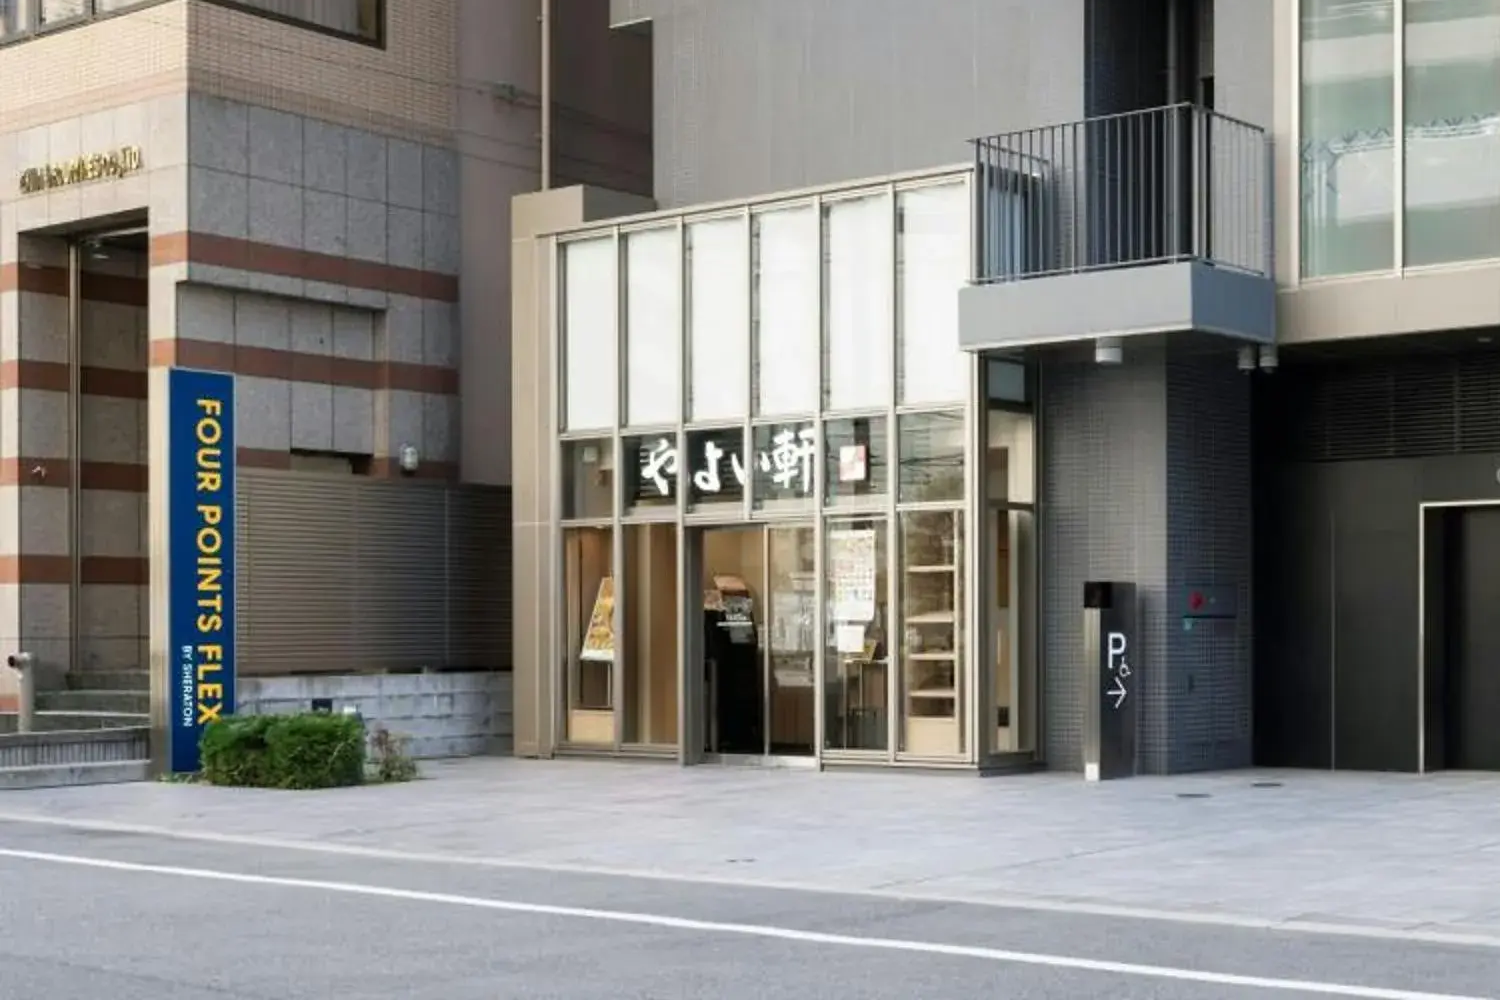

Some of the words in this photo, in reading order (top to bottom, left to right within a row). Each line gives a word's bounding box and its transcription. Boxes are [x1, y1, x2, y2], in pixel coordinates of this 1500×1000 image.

[196, 399, 222, 491] FOUR
[640, 428, 815, 496] やよい軒
[196, 505, 222, 632] POINTS
[181, 646, 192, 660] BY
[1107, 632, 1127, 668] P
[182, 663, 193, 727] SHERATON
[197, 645, 223, 724] FLEX
